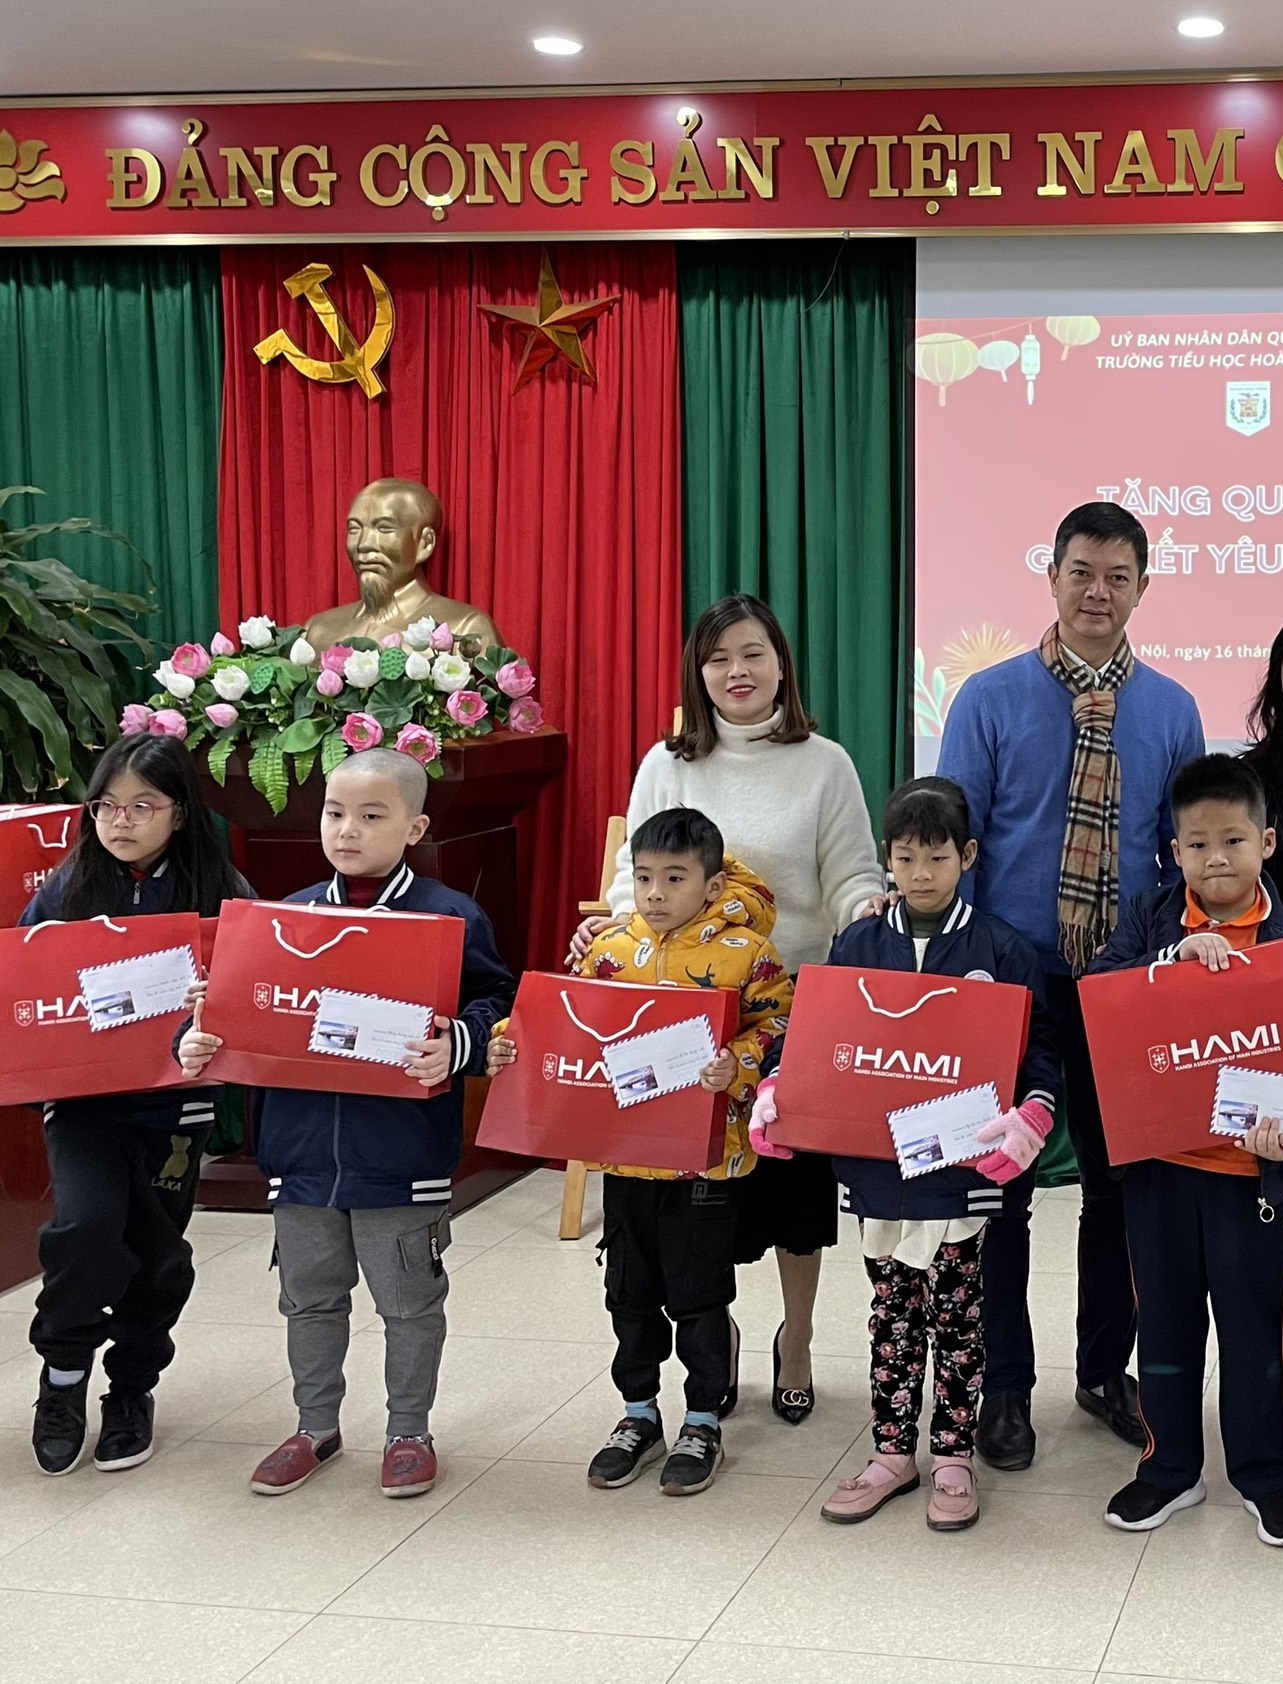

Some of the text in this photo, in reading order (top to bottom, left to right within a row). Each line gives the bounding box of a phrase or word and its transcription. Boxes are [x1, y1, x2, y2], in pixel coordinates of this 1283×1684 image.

[105, 118, 337, 208] ĐẢNG
[359, 124, 589, 221] CỘNG
[610, 106, 783, 203] SẢN
[805, 114, 1011, 215] VIỆT
[1036, 127, 1246, 196] NAM
[1137, 333, 1170, 347] BAN
[1174, 329, 1222, 346] NHÂN
[1227, 328, 1262, 345] DÂN
[1096, 352, 1164, 369] TRƯỜNG
[1209, 353, 1246, 370] HỌC
[1207, 535, 1283, 574] YÊU
[1140, 644, 1171, 660] Nội,
[1174, 645, 1212, 661] ngày
[1214, 644, 1233, 659] 16
[1237, 644, 1271, 658] thán
[37, 995, 89, 1019] HA
[273, 984, 320, 1009] HA
[1170, 1023, 1280, 1065] HAMI
[558, 1055, 611, 1081] HA
[854, 1046, 962, 1078] HAMI
